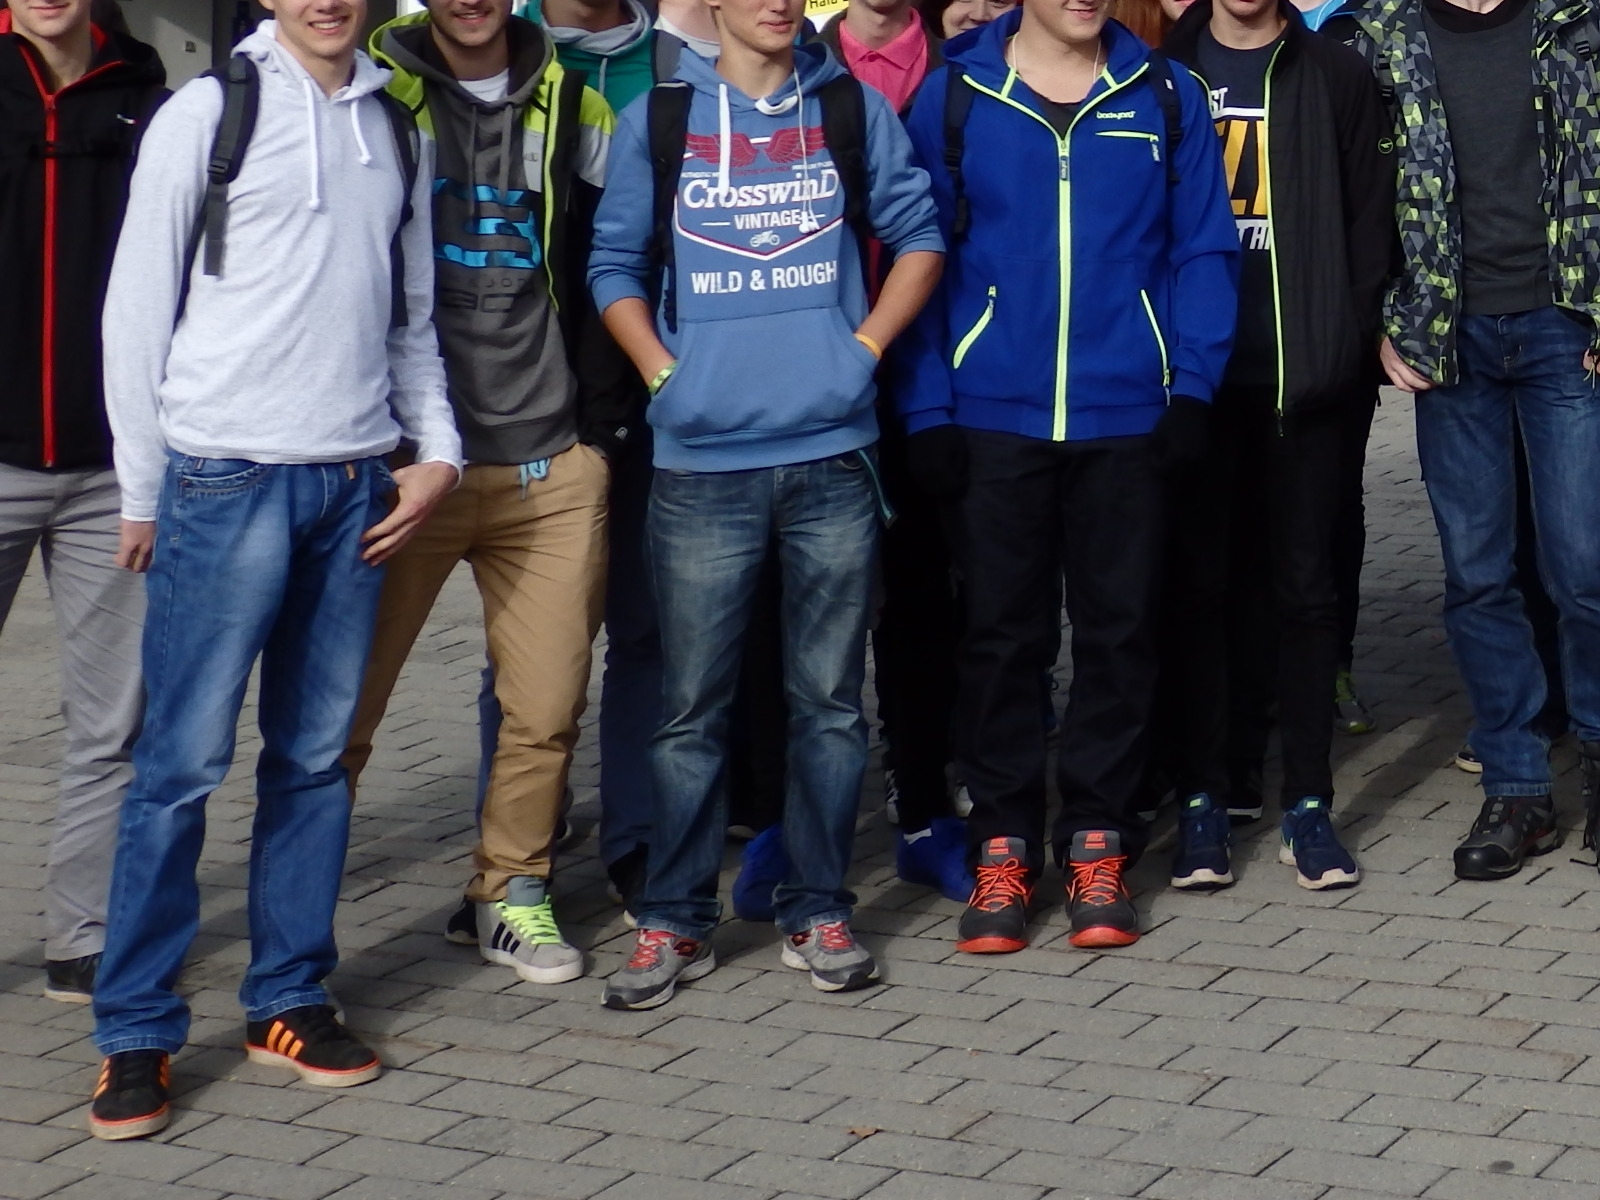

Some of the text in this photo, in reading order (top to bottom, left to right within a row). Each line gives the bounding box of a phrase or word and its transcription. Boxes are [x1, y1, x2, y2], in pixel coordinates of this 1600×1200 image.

[733, 209, 801, 230] VINTAGE
[690, 260, 838, 294] WILD & ROUGH
